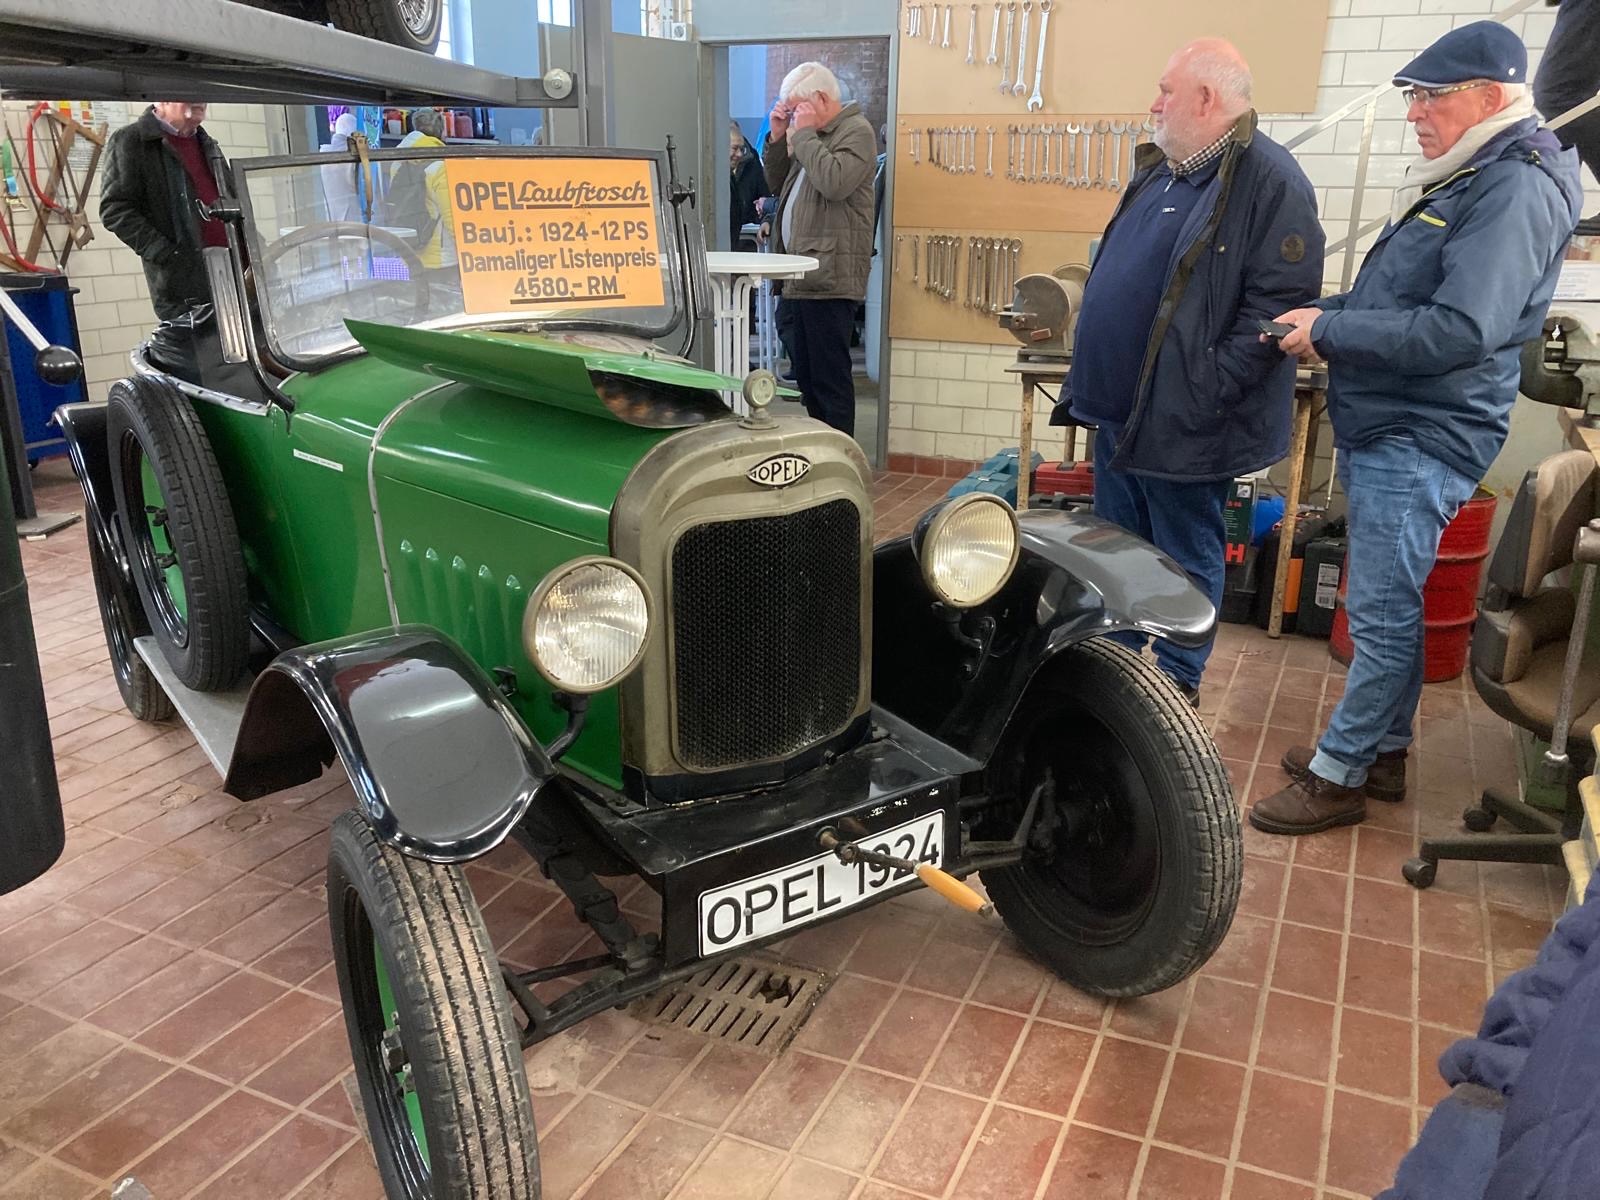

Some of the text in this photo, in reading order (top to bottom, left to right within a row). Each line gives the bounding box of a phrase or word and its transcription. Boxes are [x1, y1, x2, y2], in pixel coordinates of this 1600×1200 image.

[454, 179, 649, 212] OPEL Laubfrosch
[461, 220, 532, 245] Bauj.:
[461, 246, 657, 276] Damaliger Listenpreis
[587, 275, 618, 295] RM
[758, 459, 801, 482] OPEL
[706, 822, 940, 946] OPEL 1924
